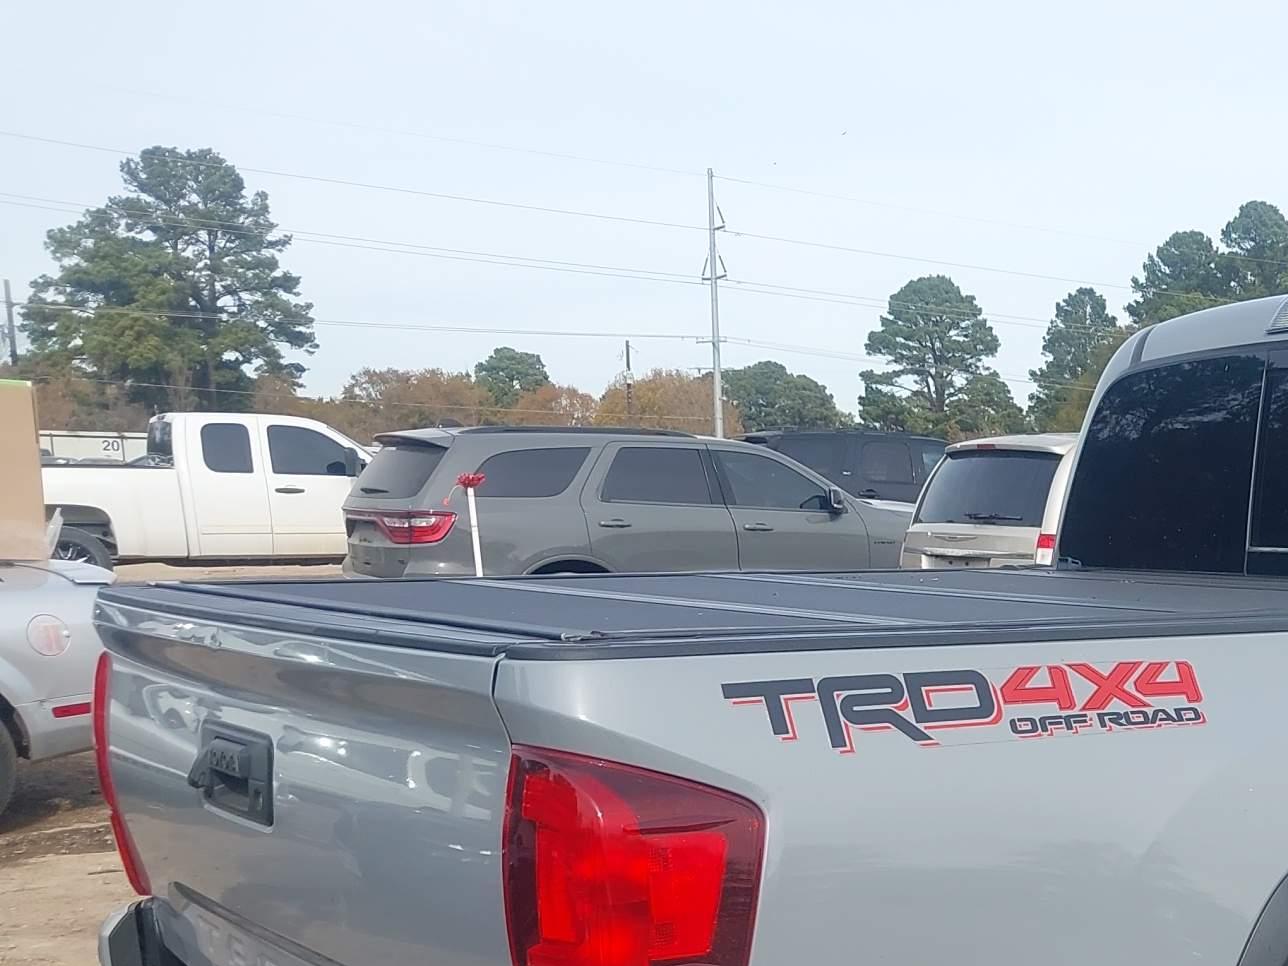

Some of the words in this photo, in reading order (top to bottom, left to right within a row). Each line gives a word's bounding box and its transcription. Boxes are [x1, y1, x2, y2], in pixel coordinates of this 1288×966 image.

[101, 439, 121, 452] 20
[720, 668, 1002, 754] TRD
[1000, 660, 1203, 712] 4X4
[1009, 713, 1093, 738] OFF
[1098, 706, 1207, 732] ROAD
